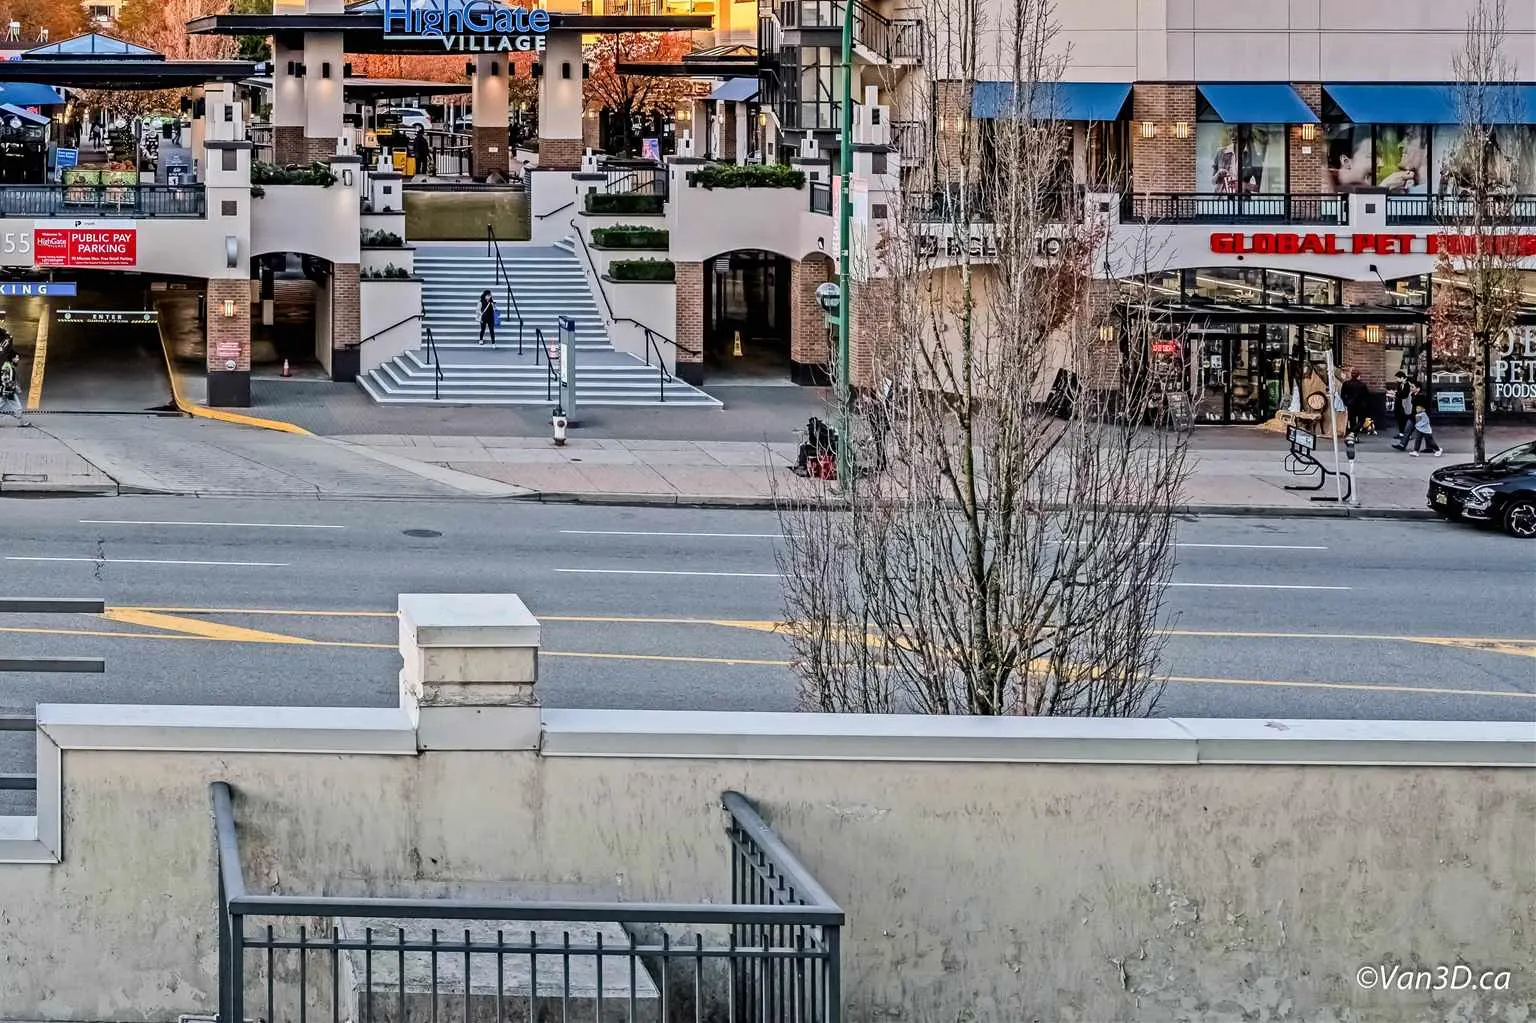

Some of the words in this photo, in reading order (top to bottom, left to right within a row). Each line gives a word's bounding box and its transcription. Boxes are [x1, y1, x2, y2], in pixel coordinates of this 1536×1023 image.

[441, 35, 546, 52] VILLAGE
[71, 233, 110, 243] PUBLIC
[113, 233, 132, 243] PAY
[1210, 233, 1344, 253] GLOBAL
[1352, 233, 1417, 254] PET
[78, 244, 126, 253] PARKING
